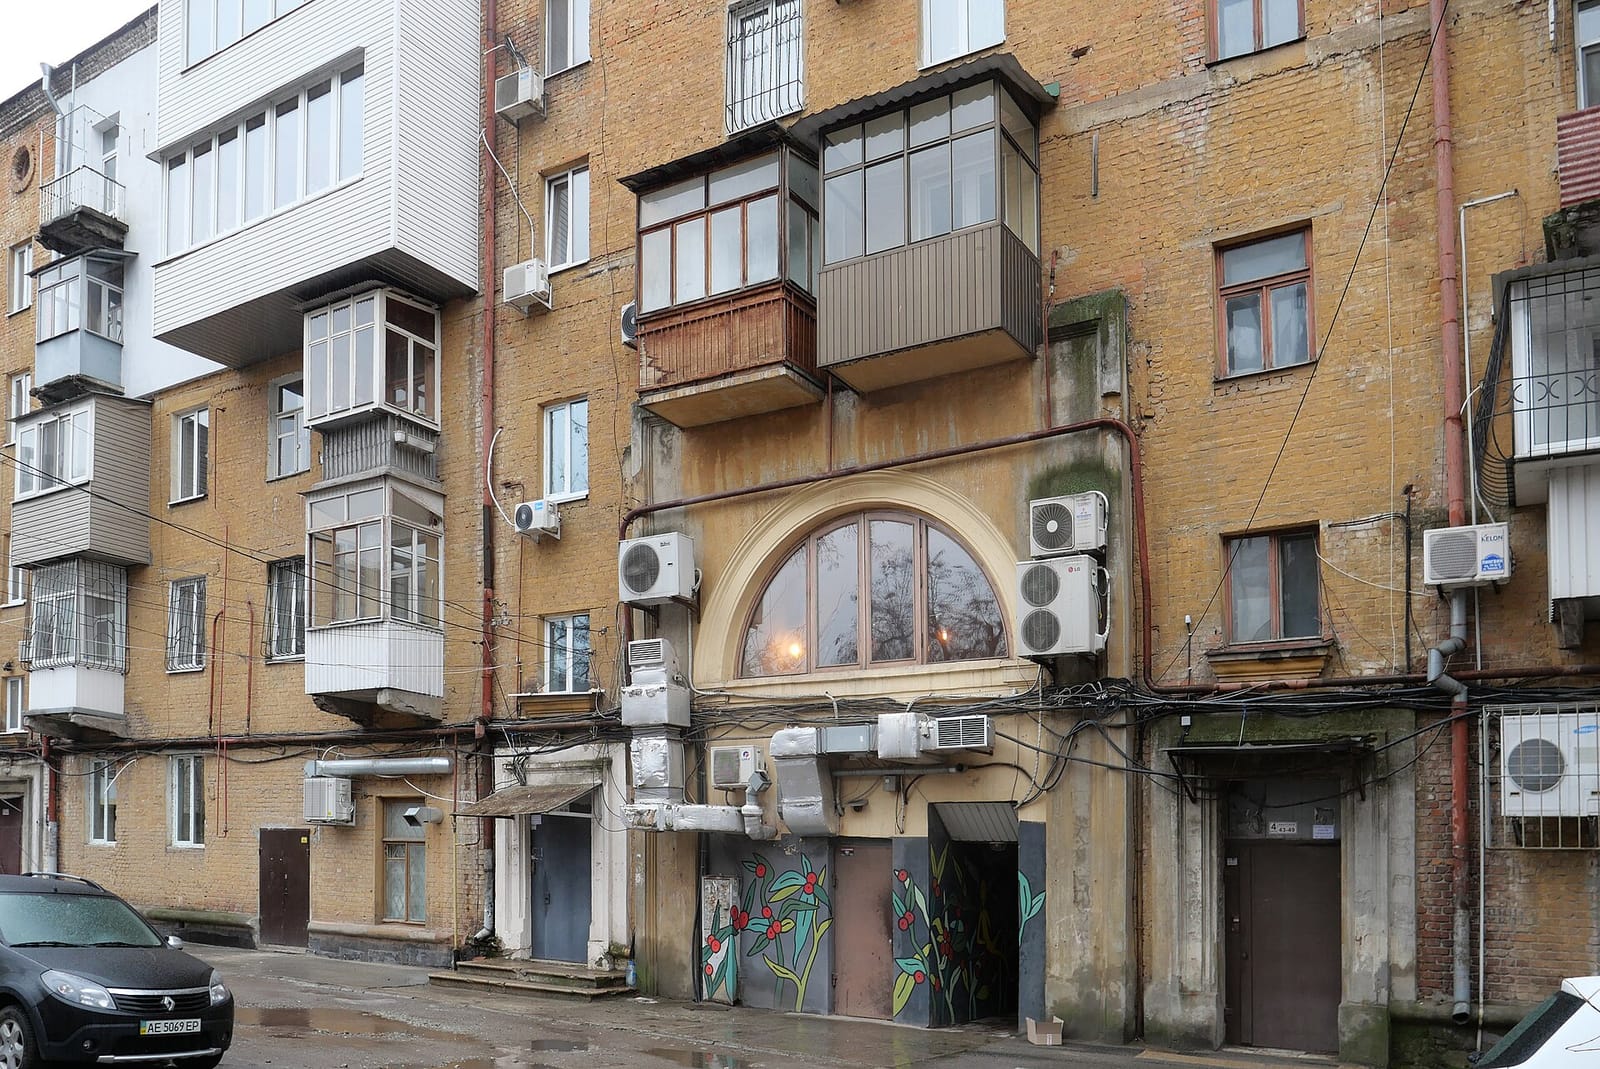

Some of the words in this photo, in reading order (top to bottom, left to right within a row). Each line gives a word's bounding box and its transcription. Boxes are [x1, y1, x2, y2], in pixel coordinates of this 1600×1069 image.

[1481, 534, 1503, 542] KELON
[147, 1022, 161, 1033] AE
[163, 1021, 185, 1032] 5069
[186, 1020, 199, 1031] EP
